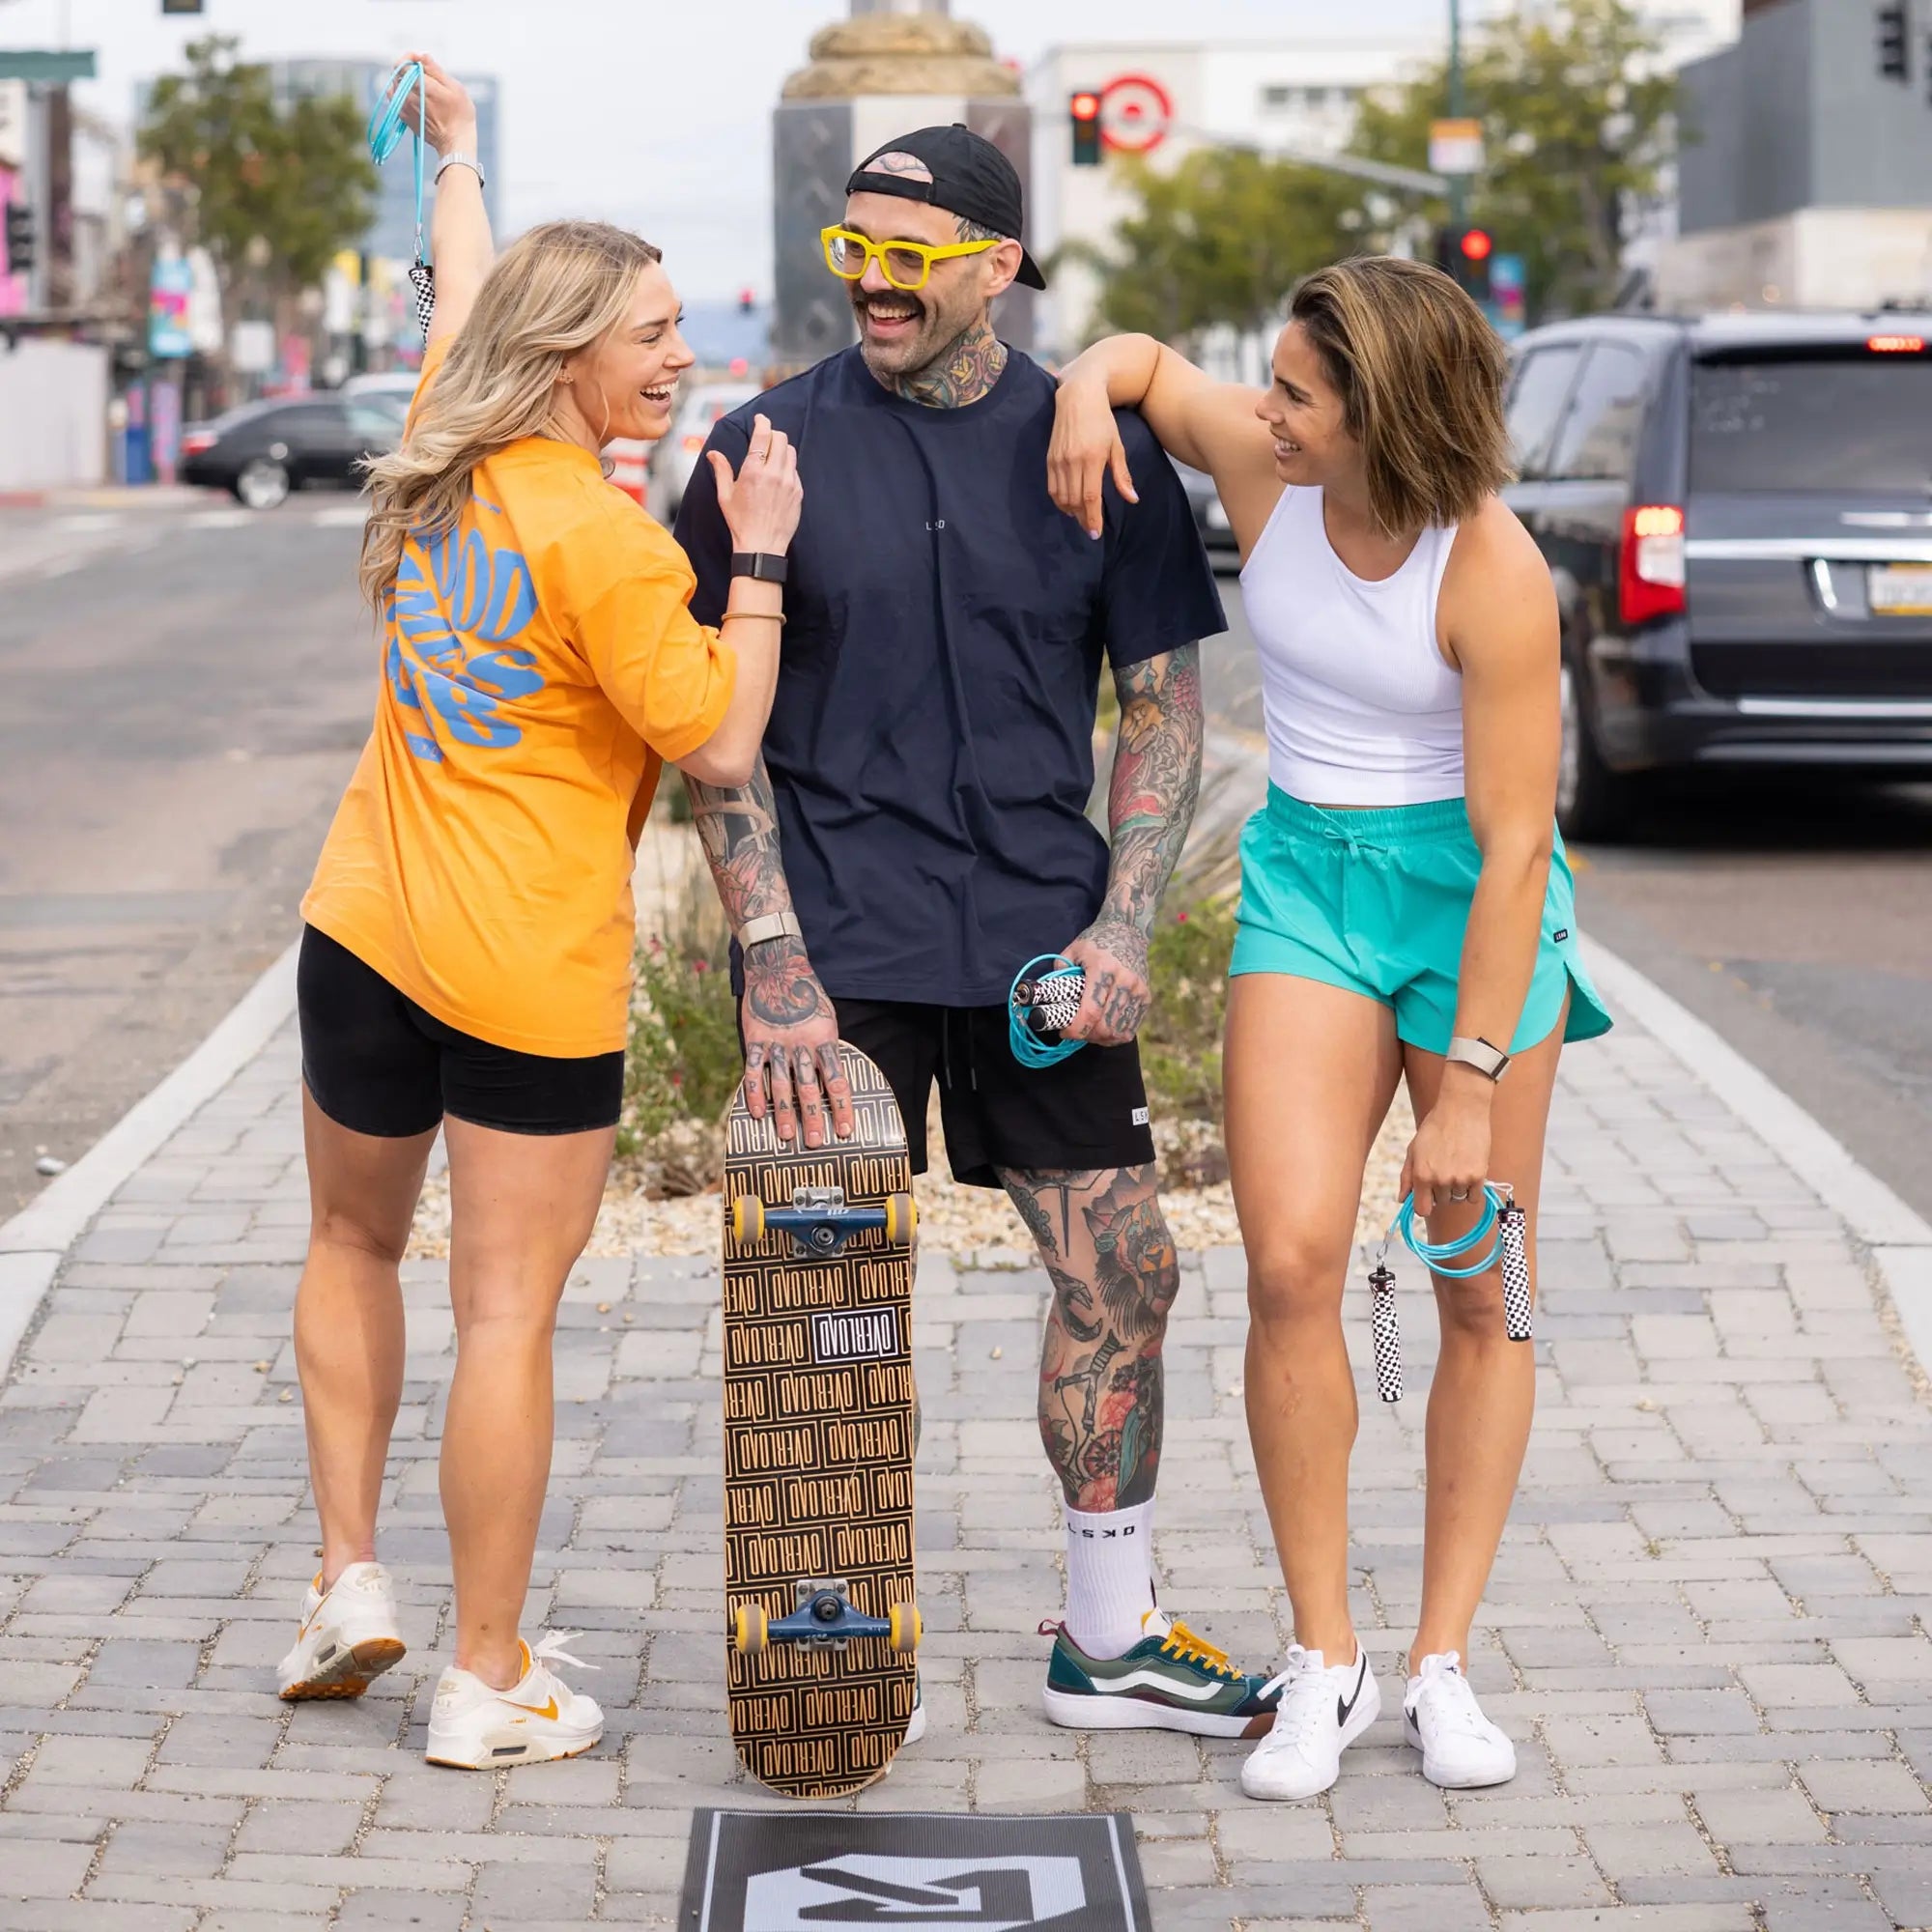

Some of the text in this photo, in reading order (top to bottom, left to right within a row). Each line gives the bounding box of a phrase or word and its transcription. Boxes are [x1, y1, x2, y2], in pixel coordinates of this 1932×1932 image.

[771, 1265, 843, 1307] OVERLOAD
[731, 1321, 803, 1364] OVERLOAD
[818, 1313, 891, 1355] OVERLOAD
[780, 1371, 852, 1412] OVERLOAD
[739, 1428, 811, 1469] OVERLOAD
[828, 1417, 898, 1460] OVERLOAD
[788, 1475, 861, 1518] OVERLOAD
[749, 1532, 820, 1575] OVERLOAD
[836, 1522, 906, 1566] OVERLOAD
[805, 1686, 875, 1724] OVERLOAD
[763, 1738, 834, 1776] OVERLOAD
